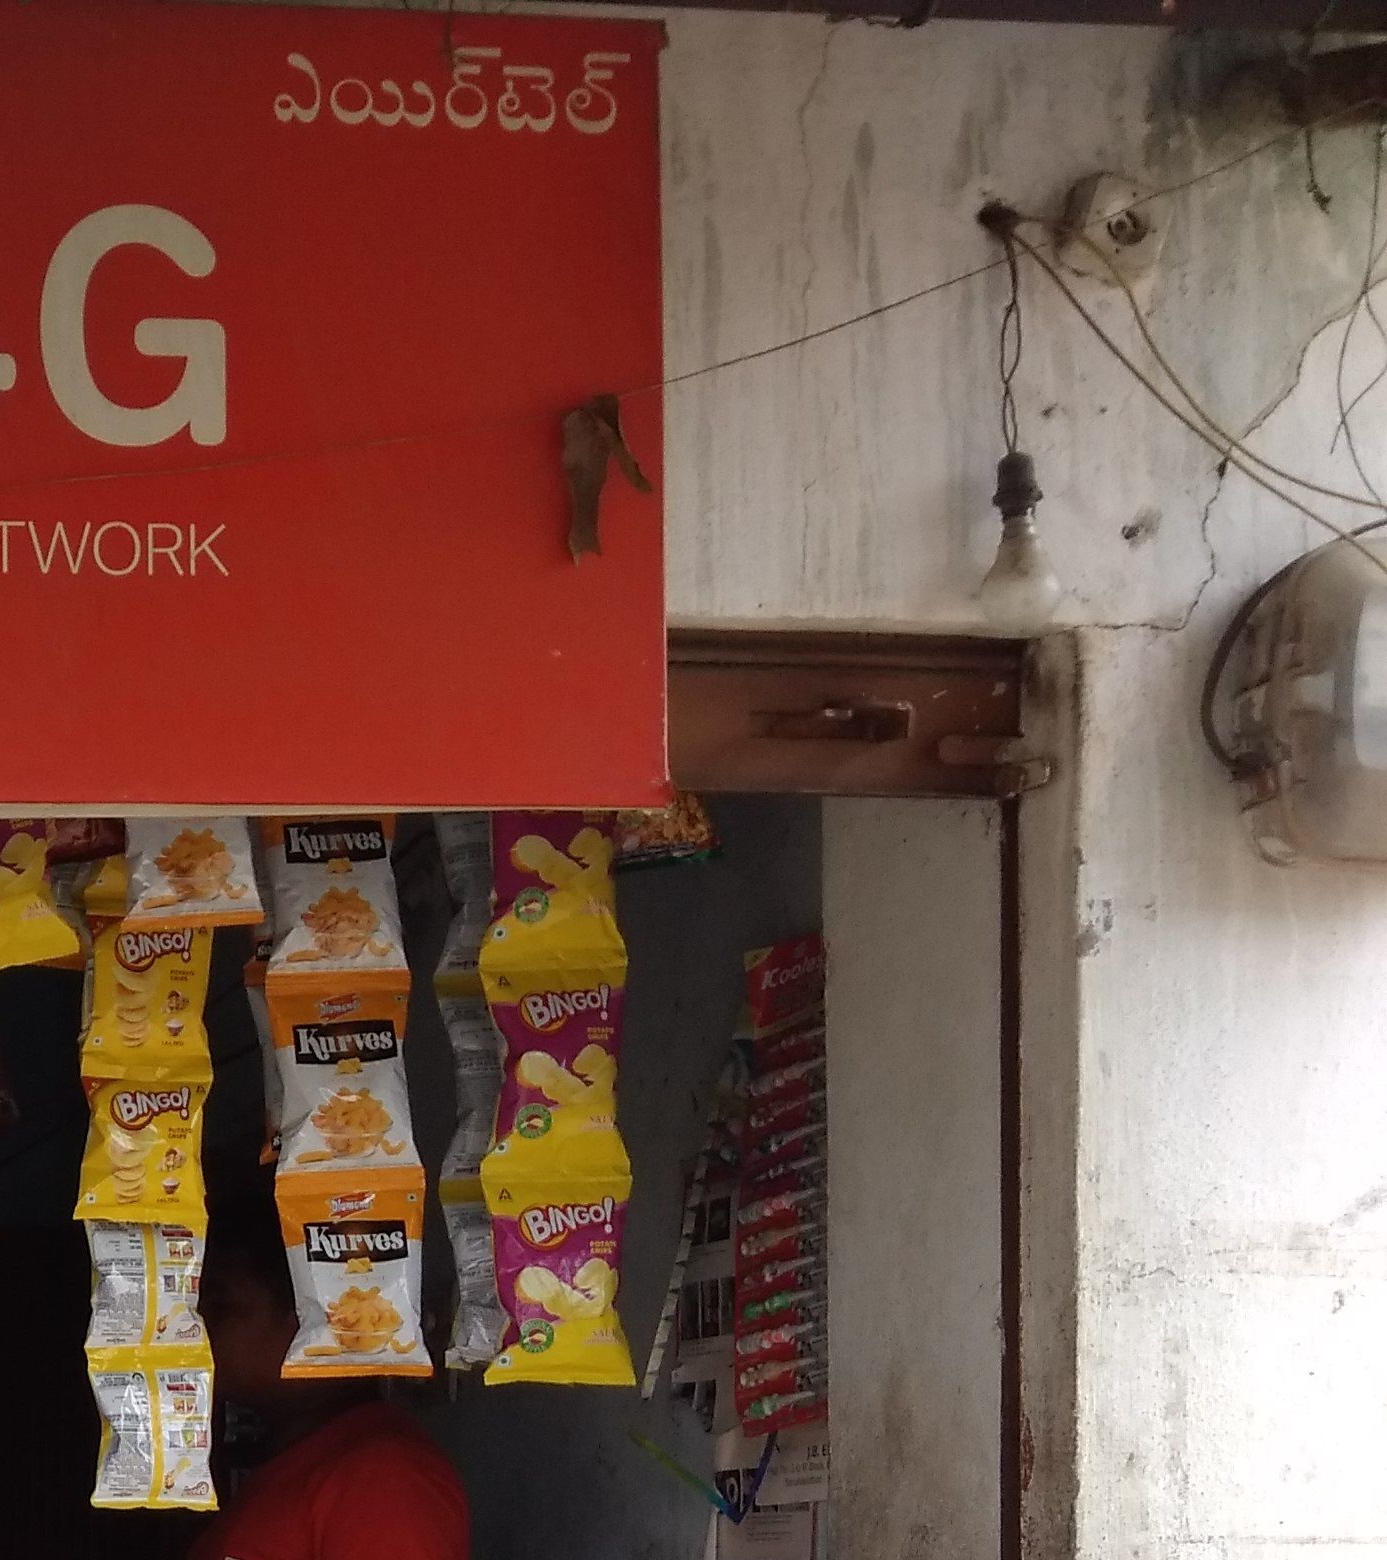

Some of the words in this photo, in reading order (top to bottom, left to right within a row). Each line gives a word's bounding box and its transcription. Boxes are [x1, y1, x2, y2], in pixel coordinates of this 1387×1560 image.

[286, 826, 383, 860] Kurves
[119, 927, 195, 963] BINGO!
[525, 984, 610, 1030] BINGO!
[296, 1027, 394, 1061] Kurves
[113, 1086, 192, 1122] BINGO!
[524, 1196, 615, 1243] BINGO!
[306, 1225, 406, 1260] Kurves
